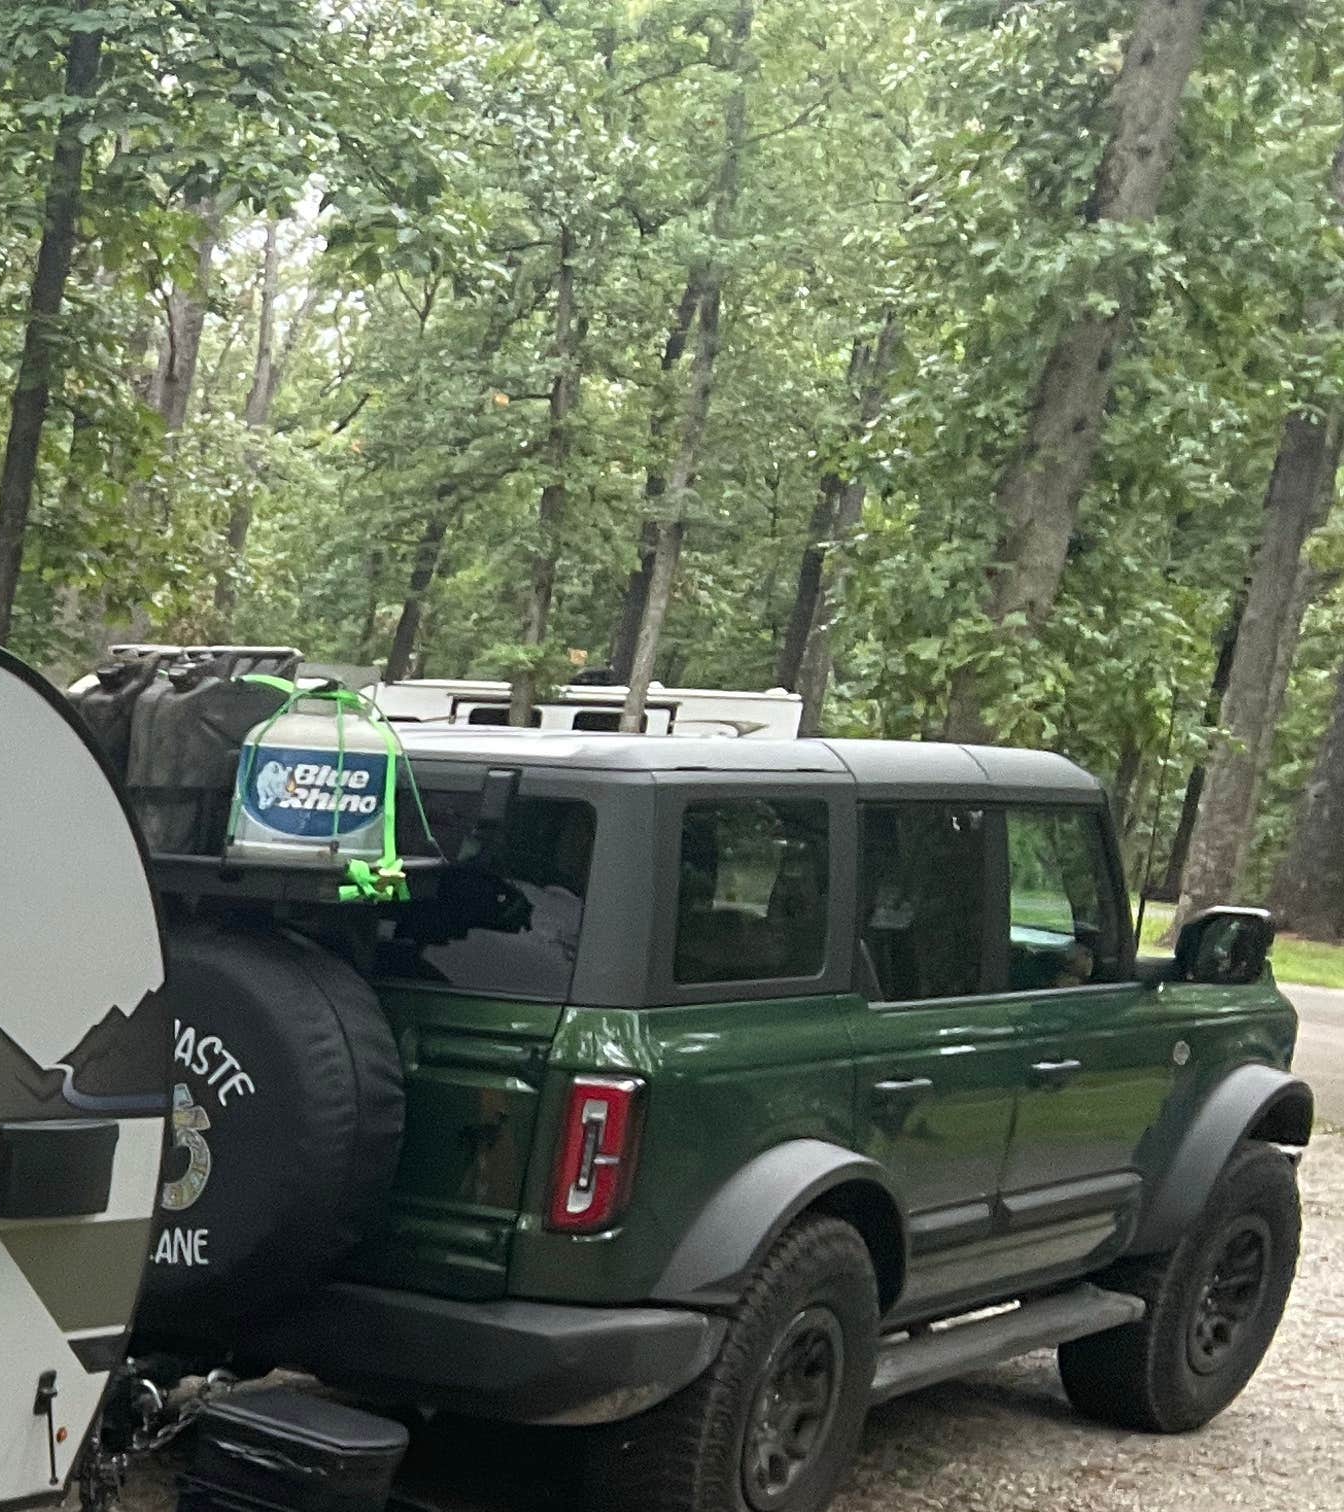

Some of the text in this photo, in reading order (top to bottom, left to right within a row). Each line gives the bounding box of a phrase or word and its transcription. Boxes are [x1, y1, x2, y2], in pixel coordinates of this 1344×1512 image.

[294, 763, 370, 789] Blue
[279, 787, 378, 814] Rhino
[174, 1018, 256, 1107] ASTE
[150, 1226, 210, 1267] ANE
